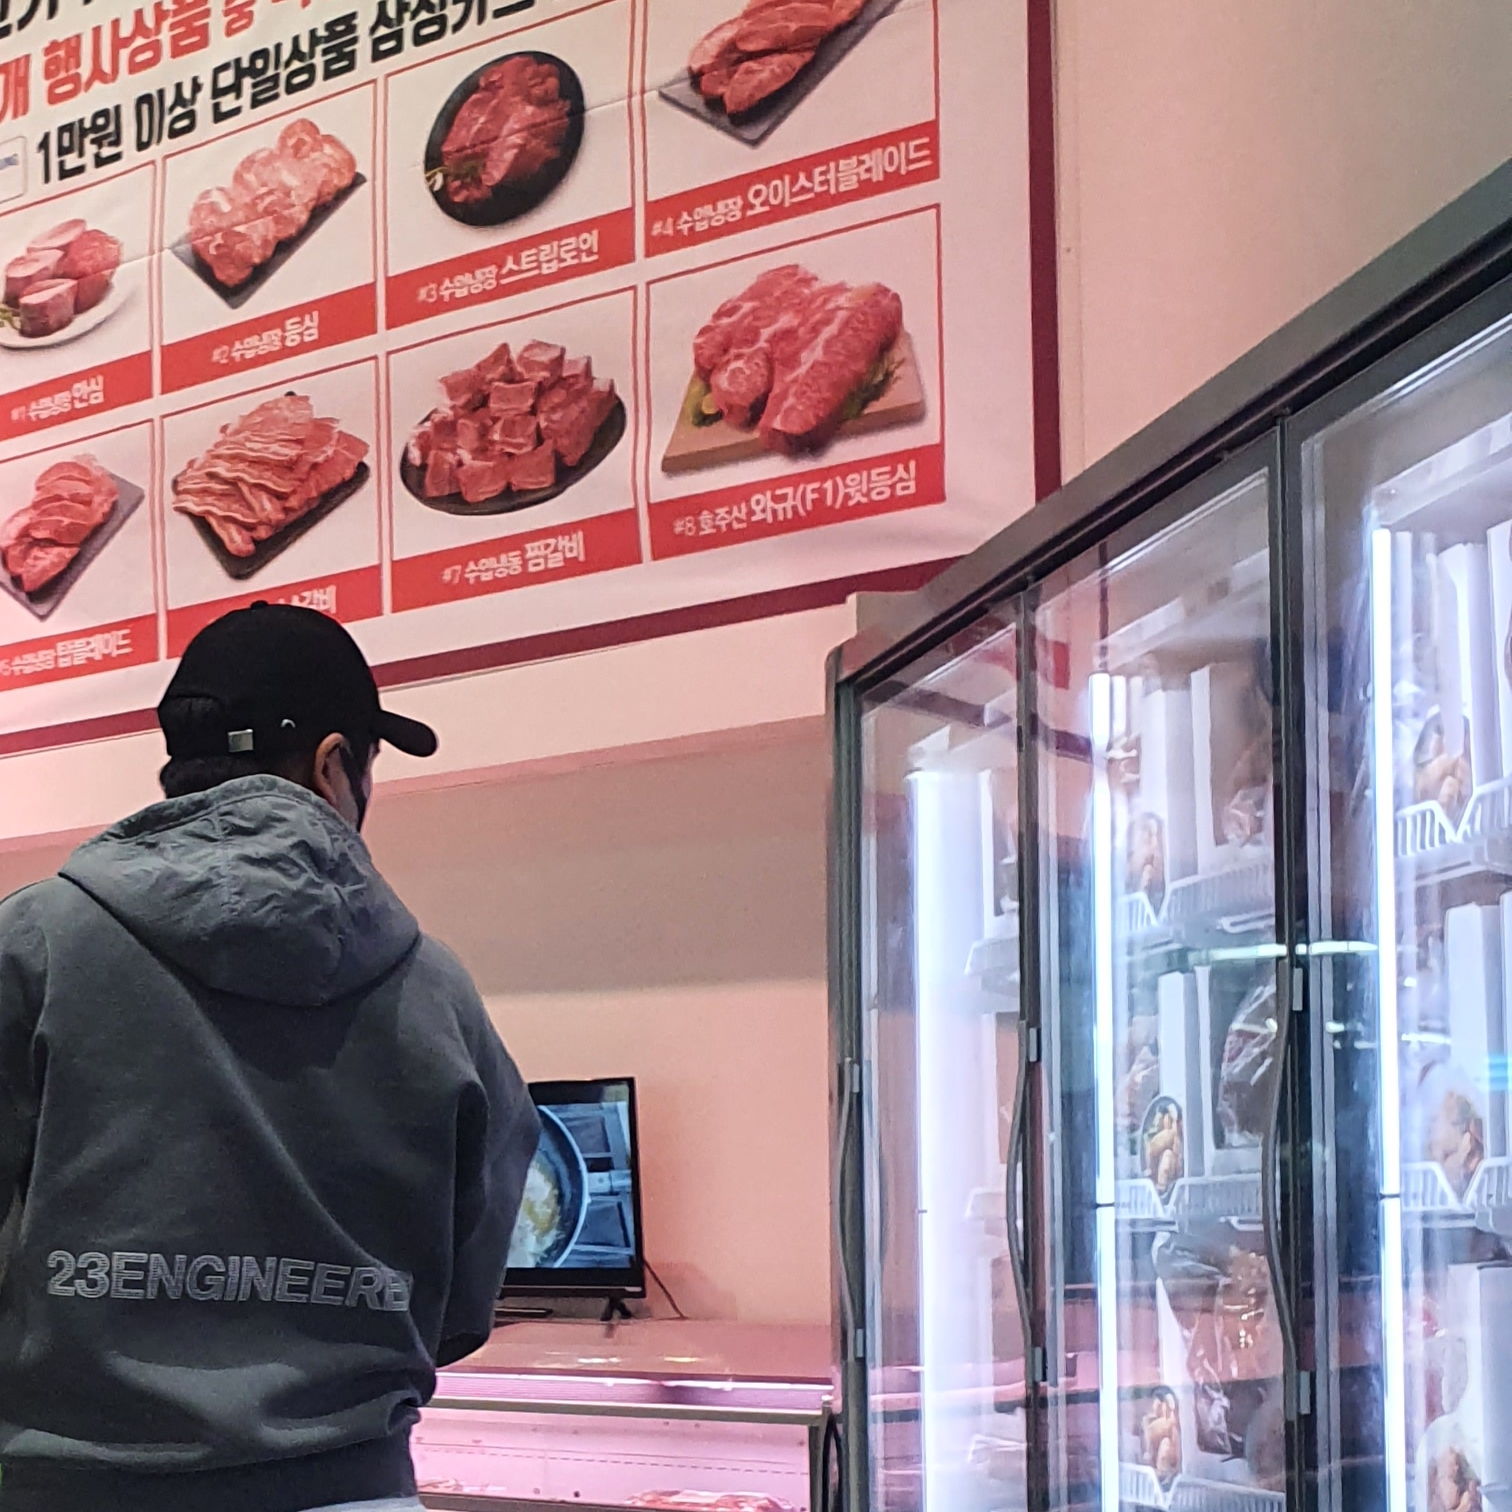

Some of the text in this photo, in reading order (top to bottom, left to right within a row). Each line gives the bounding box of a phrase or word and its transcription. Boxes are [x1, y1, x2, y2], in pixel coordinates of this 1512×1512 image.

[37, 104, 123, 185] 1만원
[134, 75, 203, 152] 이상
[211, 10, 359, 124] 단일상품
[745, 136, 934, 217] 오이스터블레이드
[500, 229, 599, 285] 스트립로인
[284, 310, 319, 348] 등심
[698, 502, 748, 537] 호주산
